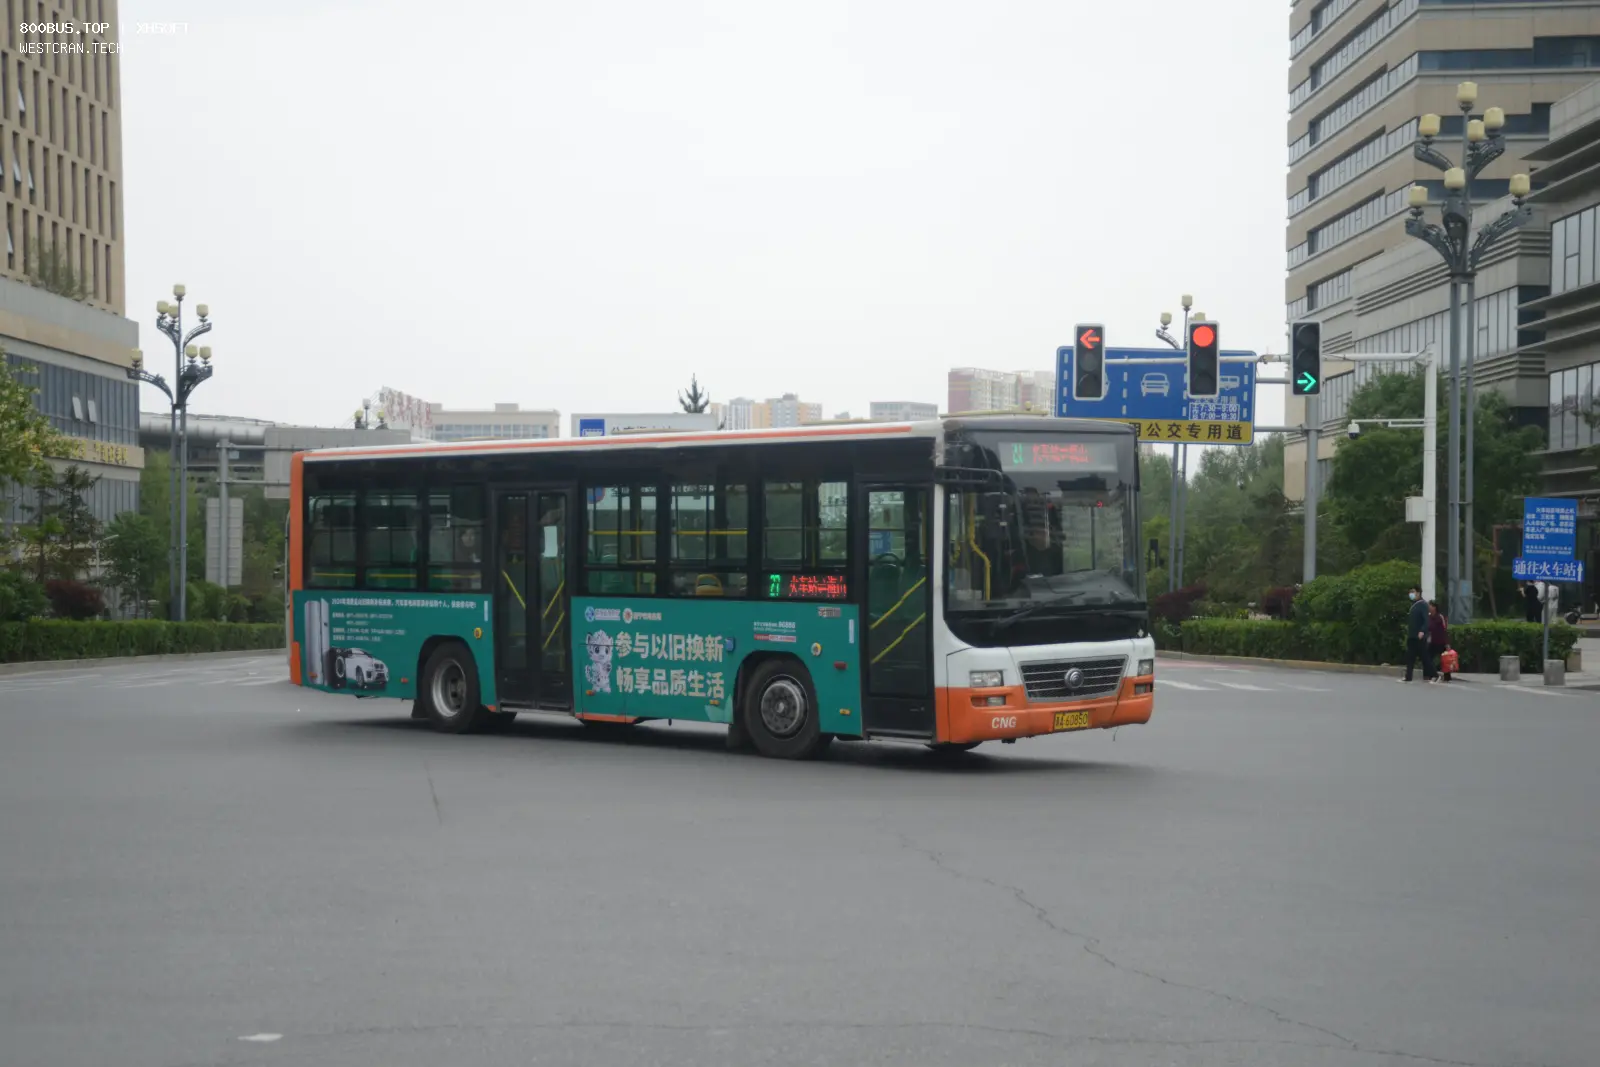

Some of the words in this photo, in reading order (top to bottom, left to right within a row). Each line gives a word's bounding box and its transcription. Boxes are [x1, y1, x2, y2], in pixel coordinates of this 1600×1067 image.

[1514, 561, 1576, 576] 通往火车站
[615, 631, 724, 662] 参与以旧换新
[616, 666, 725, 699] 畅享品质生活
[991, 716, 1018, 729] CNG
